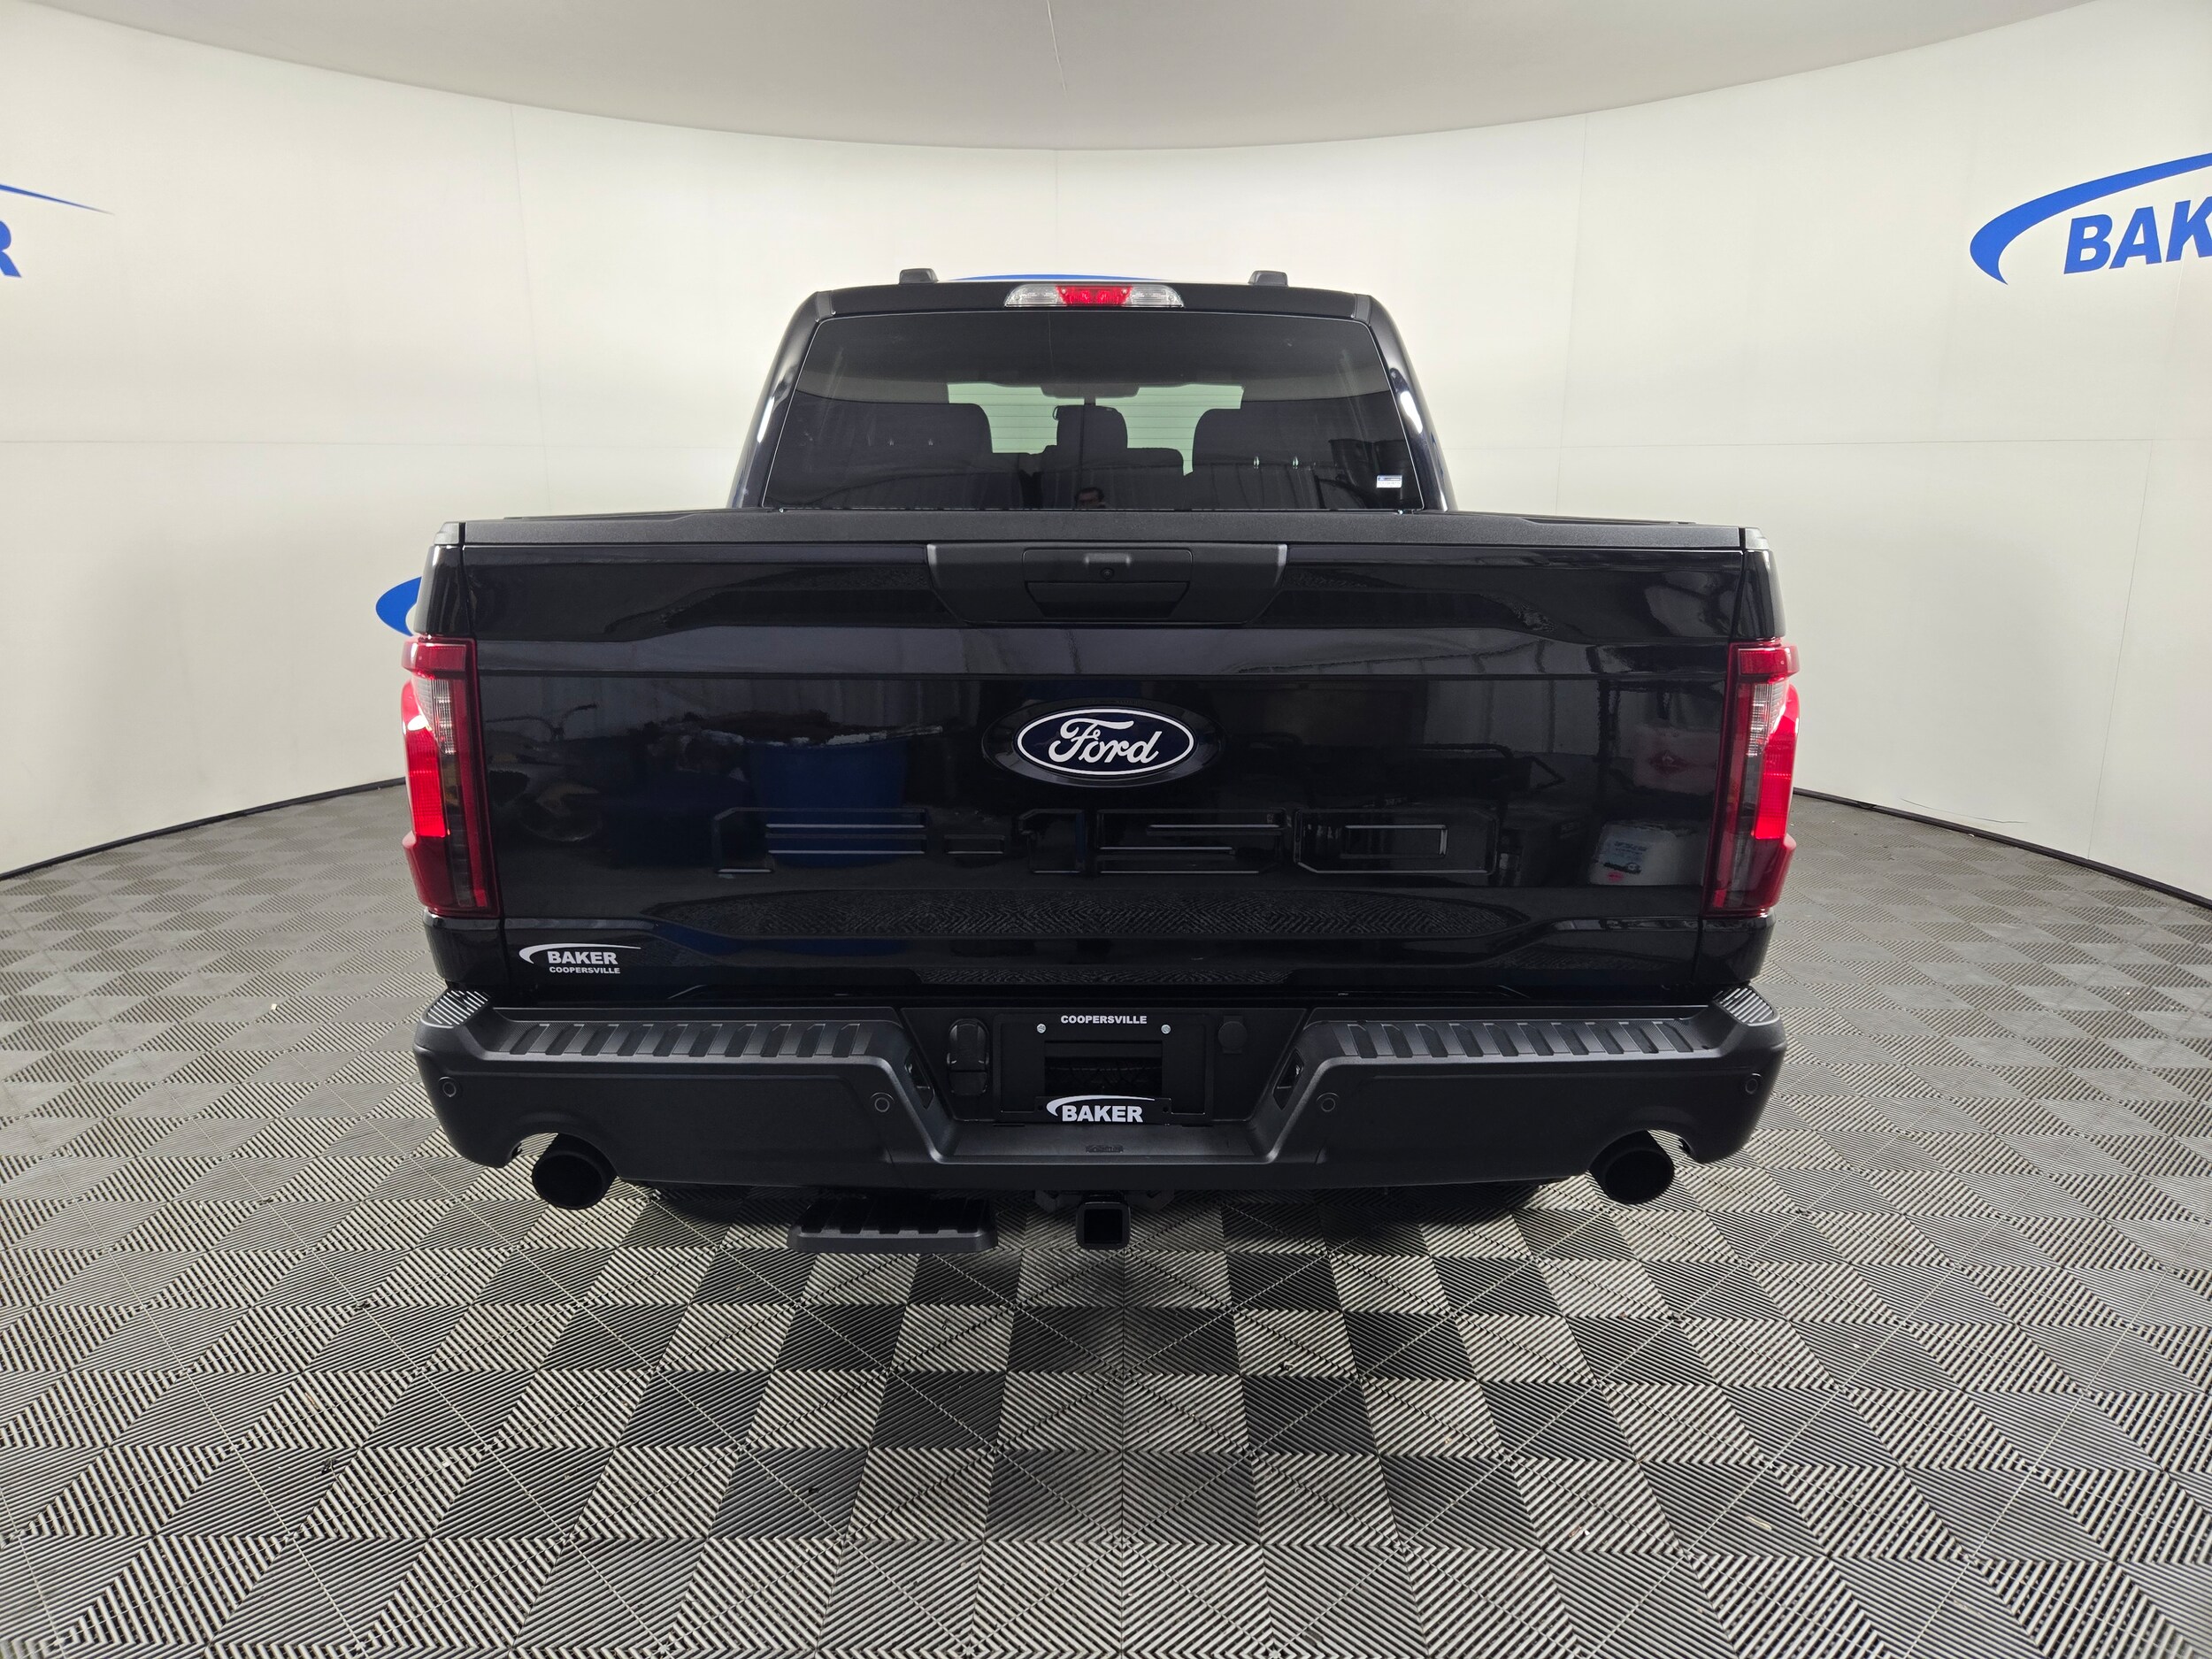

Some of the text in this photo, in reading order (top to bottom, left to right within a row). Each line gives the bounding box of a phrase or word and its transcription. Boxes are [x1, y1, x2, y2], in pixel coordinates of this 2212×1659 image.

[1048, 718, 1163, 764] Ford
[712, 807, 1499, 874] F-150
[547, 950, 618, 965] BAKER
[1060, 1015, 1148, 1025] COOPERSVILLE
[1062, 1105, 1144, 1123] BAKER
